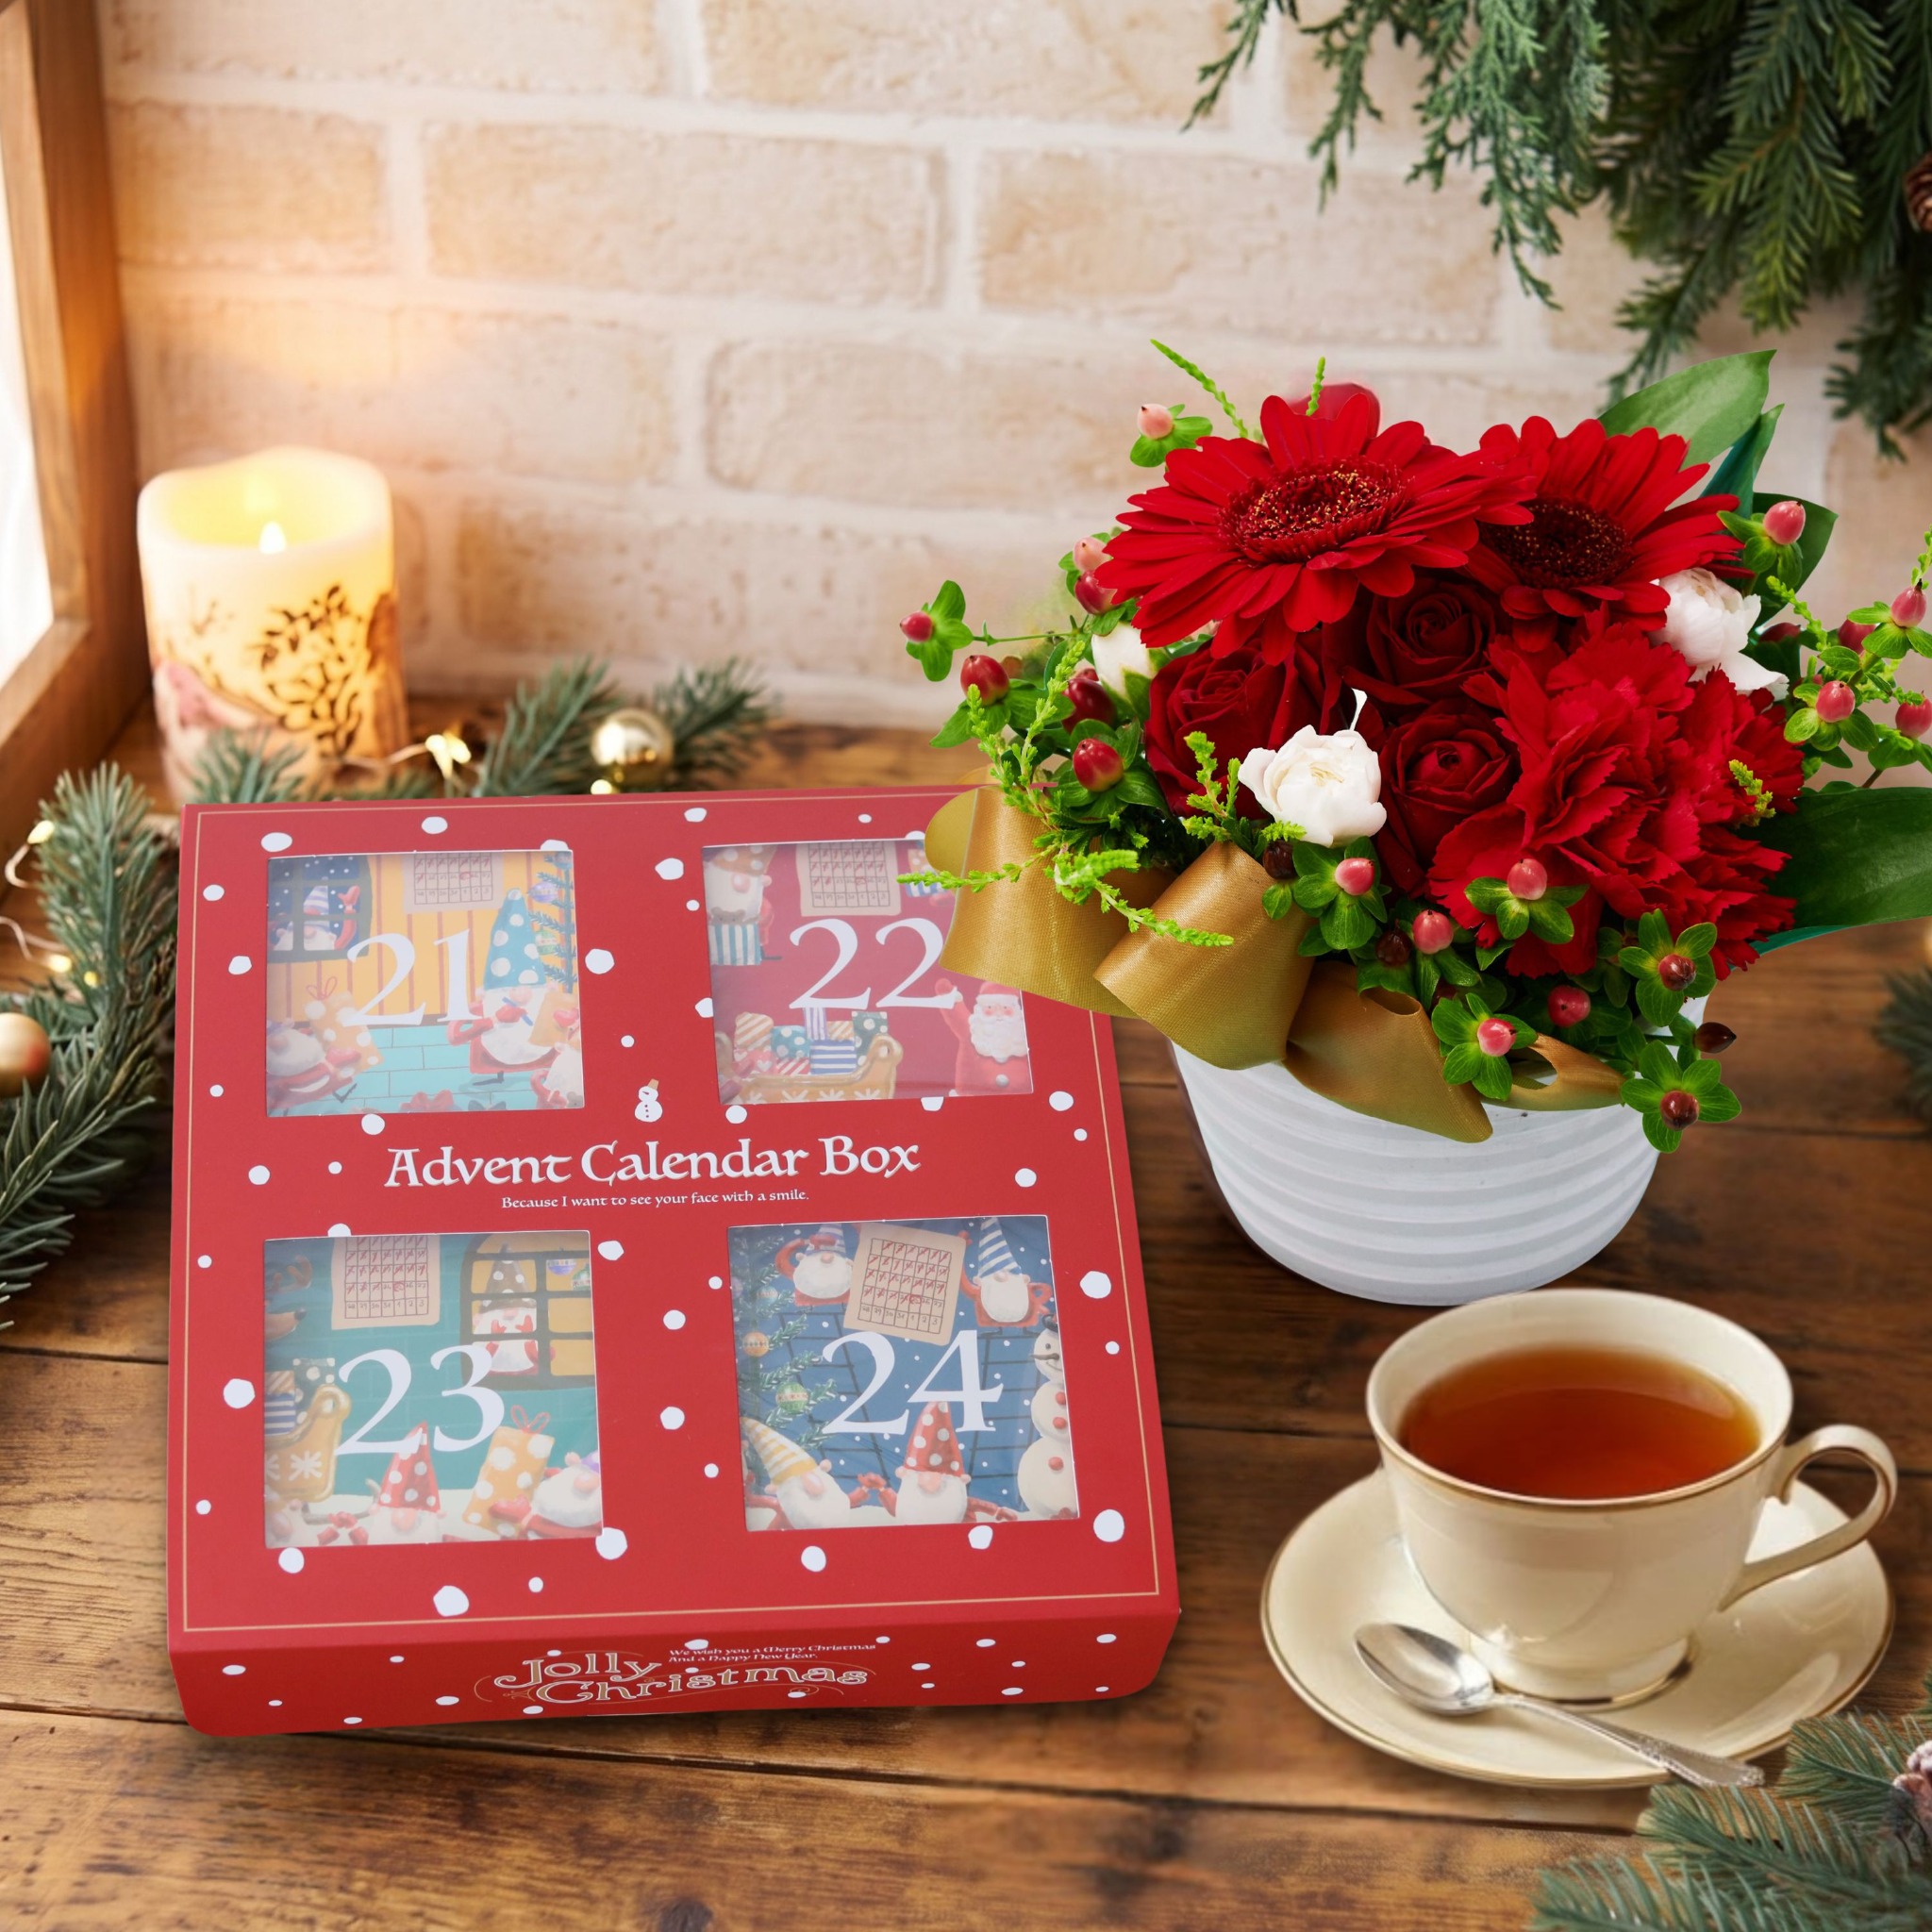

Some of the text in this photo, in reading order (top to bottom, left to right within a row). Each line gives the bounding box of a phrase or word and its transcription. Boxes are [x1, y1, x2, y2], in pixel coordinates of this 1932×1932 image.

[343, 928, 483, 1027] 21
[789, 917, 958, 1010] 22
[384, 1135, 922, 1187] Advent Calendar Box
[502, 1189, 809, 1208] Because I want to see your face with a smile.
[334, 1344, 505, 1456] 23
[822, 1329, 1004, 1436] 24
[493, 1652, 662, 1689] Jolly
[693, 1647, 723, 1656] wish
[725, 1647, 750, 1656] you
[763, 1645, 806, 1654] Merry
[808, 1643, 876, 1652] Christmas
[536, 1665, 868, 1704] Christmas
